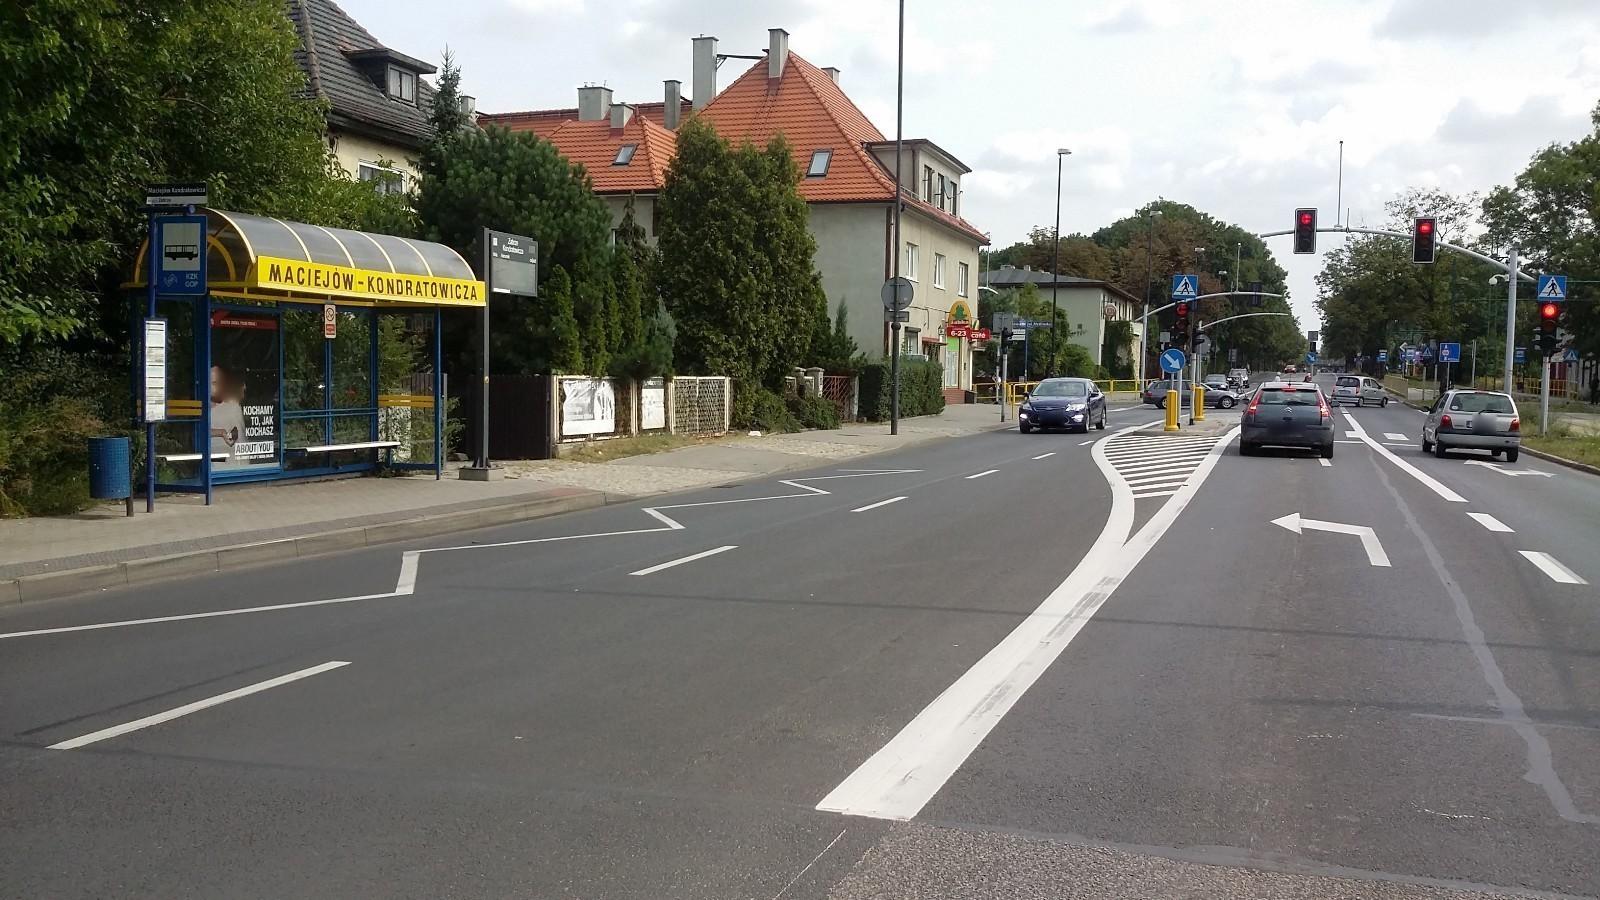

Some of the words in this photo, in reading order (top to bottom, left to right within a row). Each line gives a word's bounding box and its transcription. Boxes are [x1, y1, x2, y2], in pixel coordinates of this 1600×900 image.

[243, 405, 274, 415] KOCHAMY
[251, 416, 260, 426] TO,
[261, 415, 274, 425] JAK
[245, 426, 274, 437] KOCHASZ
[235, 443, 257, 454] ABOUT
